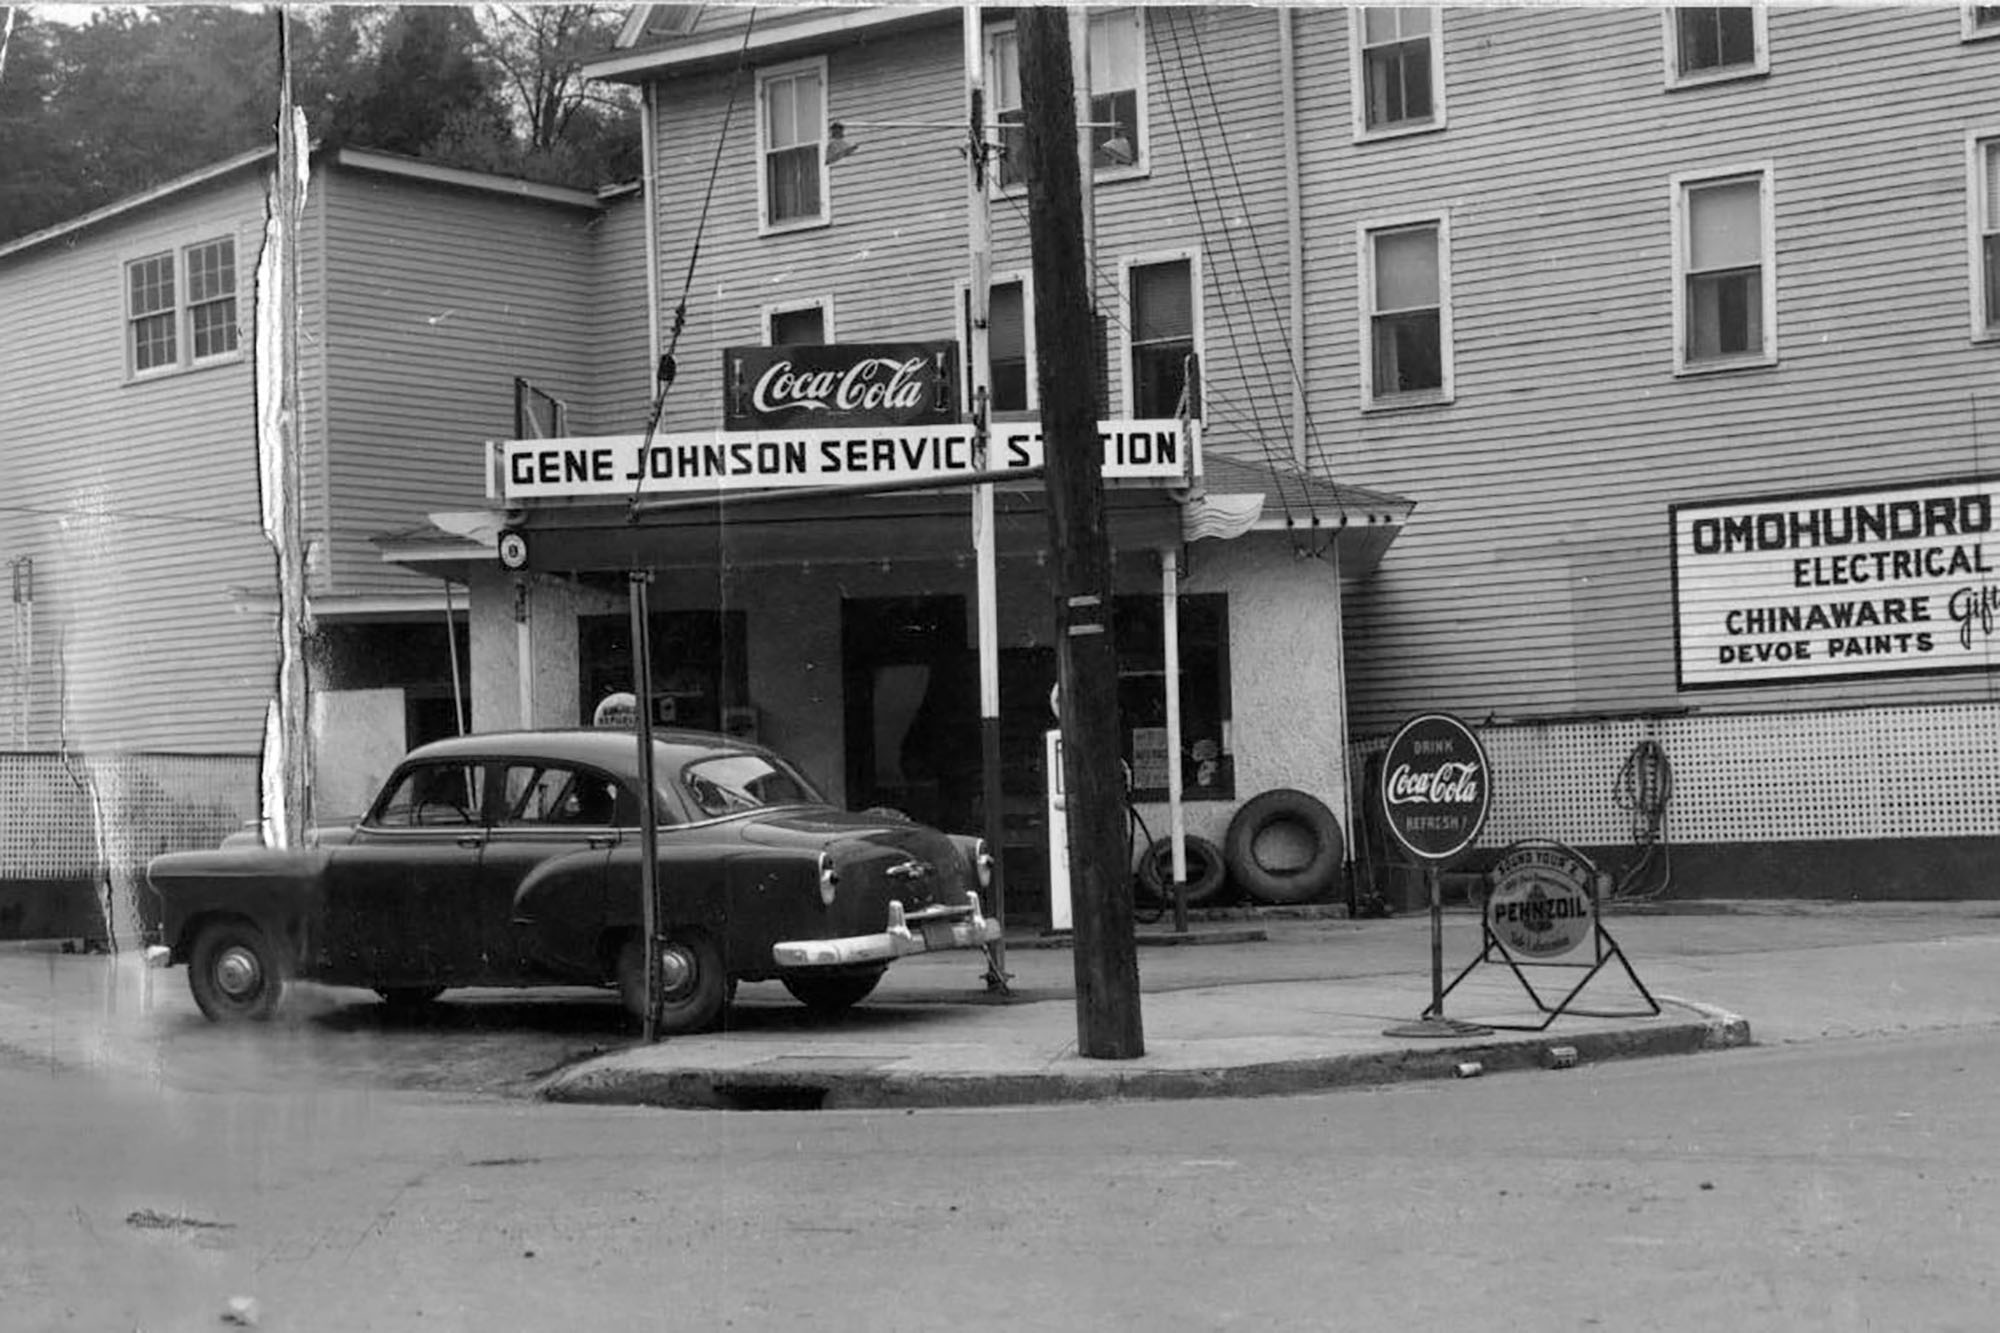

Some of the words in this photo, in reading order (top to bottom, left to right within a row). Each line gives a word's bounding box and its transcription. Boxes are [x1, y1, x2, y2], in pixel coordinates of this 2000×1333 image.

[753, 357, 929, 412] Coca-Cola
[511, 449, 613, 484] GENE
[626, 441, 806, 480] JOHNSON
[1008, 431, 1176, 467] STION
[1692, 493, 1991, 555] OMOHUNDRO
[1793, 543, 1993, 588] ELECTRICAL
[1725, 596, 1931, 635] CHINAWARE
[1949, 585, 2000, 650] Gift
[1718, 640, 1811, 664] DEVOE
[1828, 632, 1934, 658] PAINTS
[1413, 740, 1454, 755] DRINK
[1388, 761, 1480, 804] Coca-Cola
[1495, 897, 1586, 924] PENNZOIL
